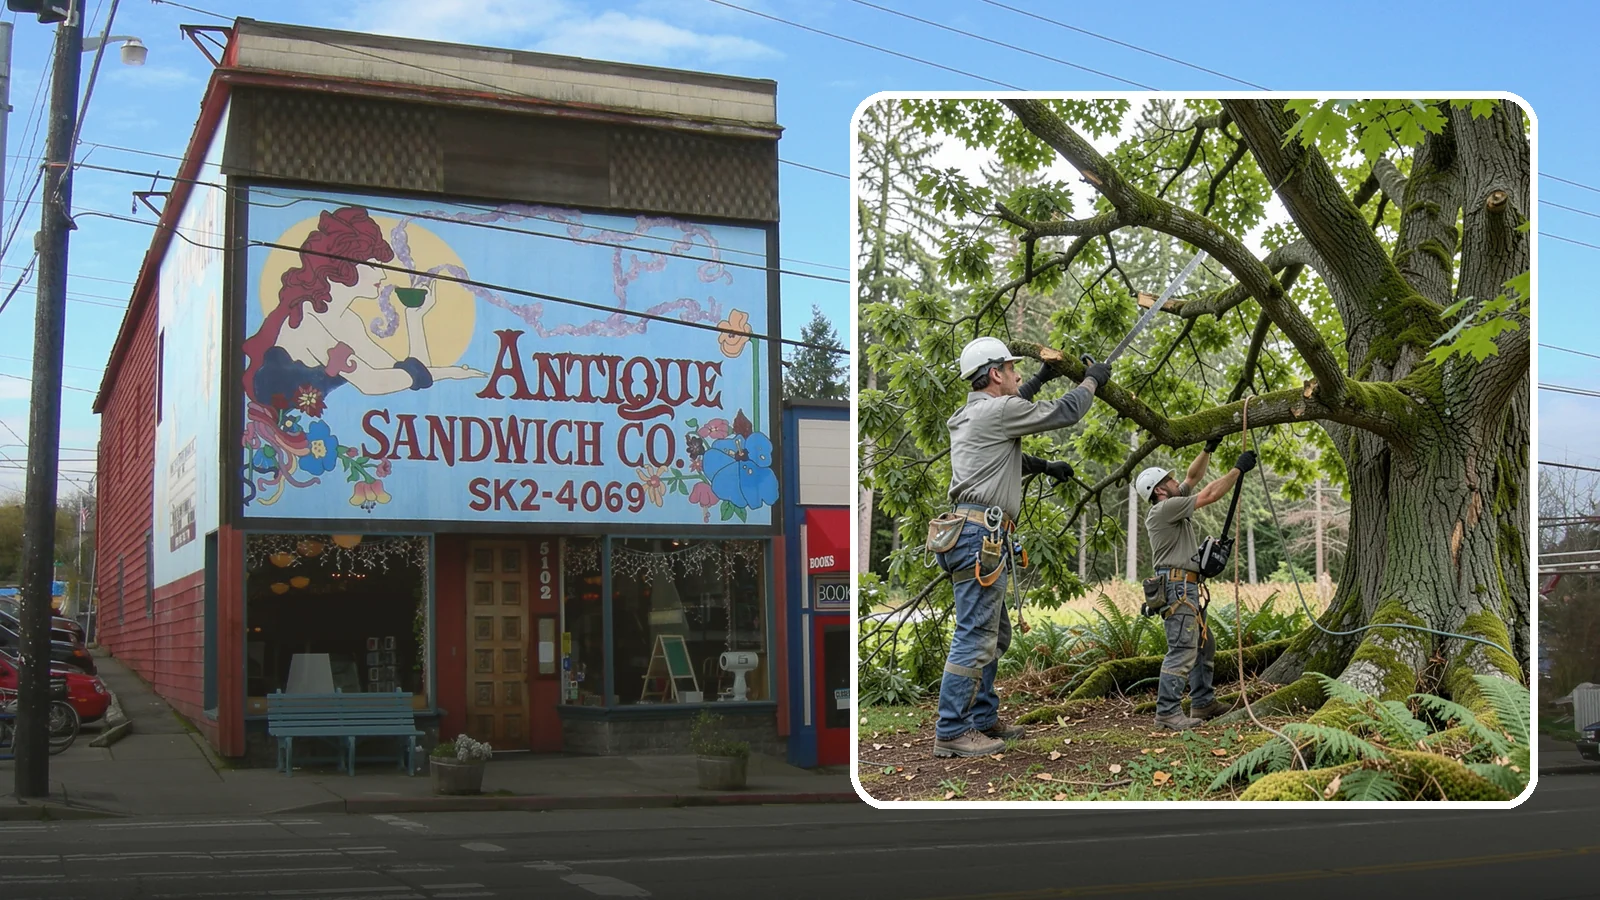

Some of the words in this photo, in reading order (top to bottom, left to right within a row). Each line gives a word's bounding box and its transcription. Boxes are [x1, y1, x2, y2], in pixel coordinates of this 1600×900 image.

[476, 329, 723, 421] ANTIQUE
[361, 409, 604, 467] SANDWICH
[616, 421, 684, 469] CO.
[468, 478, 646, 514] SK2-4069
[540, 541, 551, 600] 5102
[809, 555, 834, 568] BOOKS
